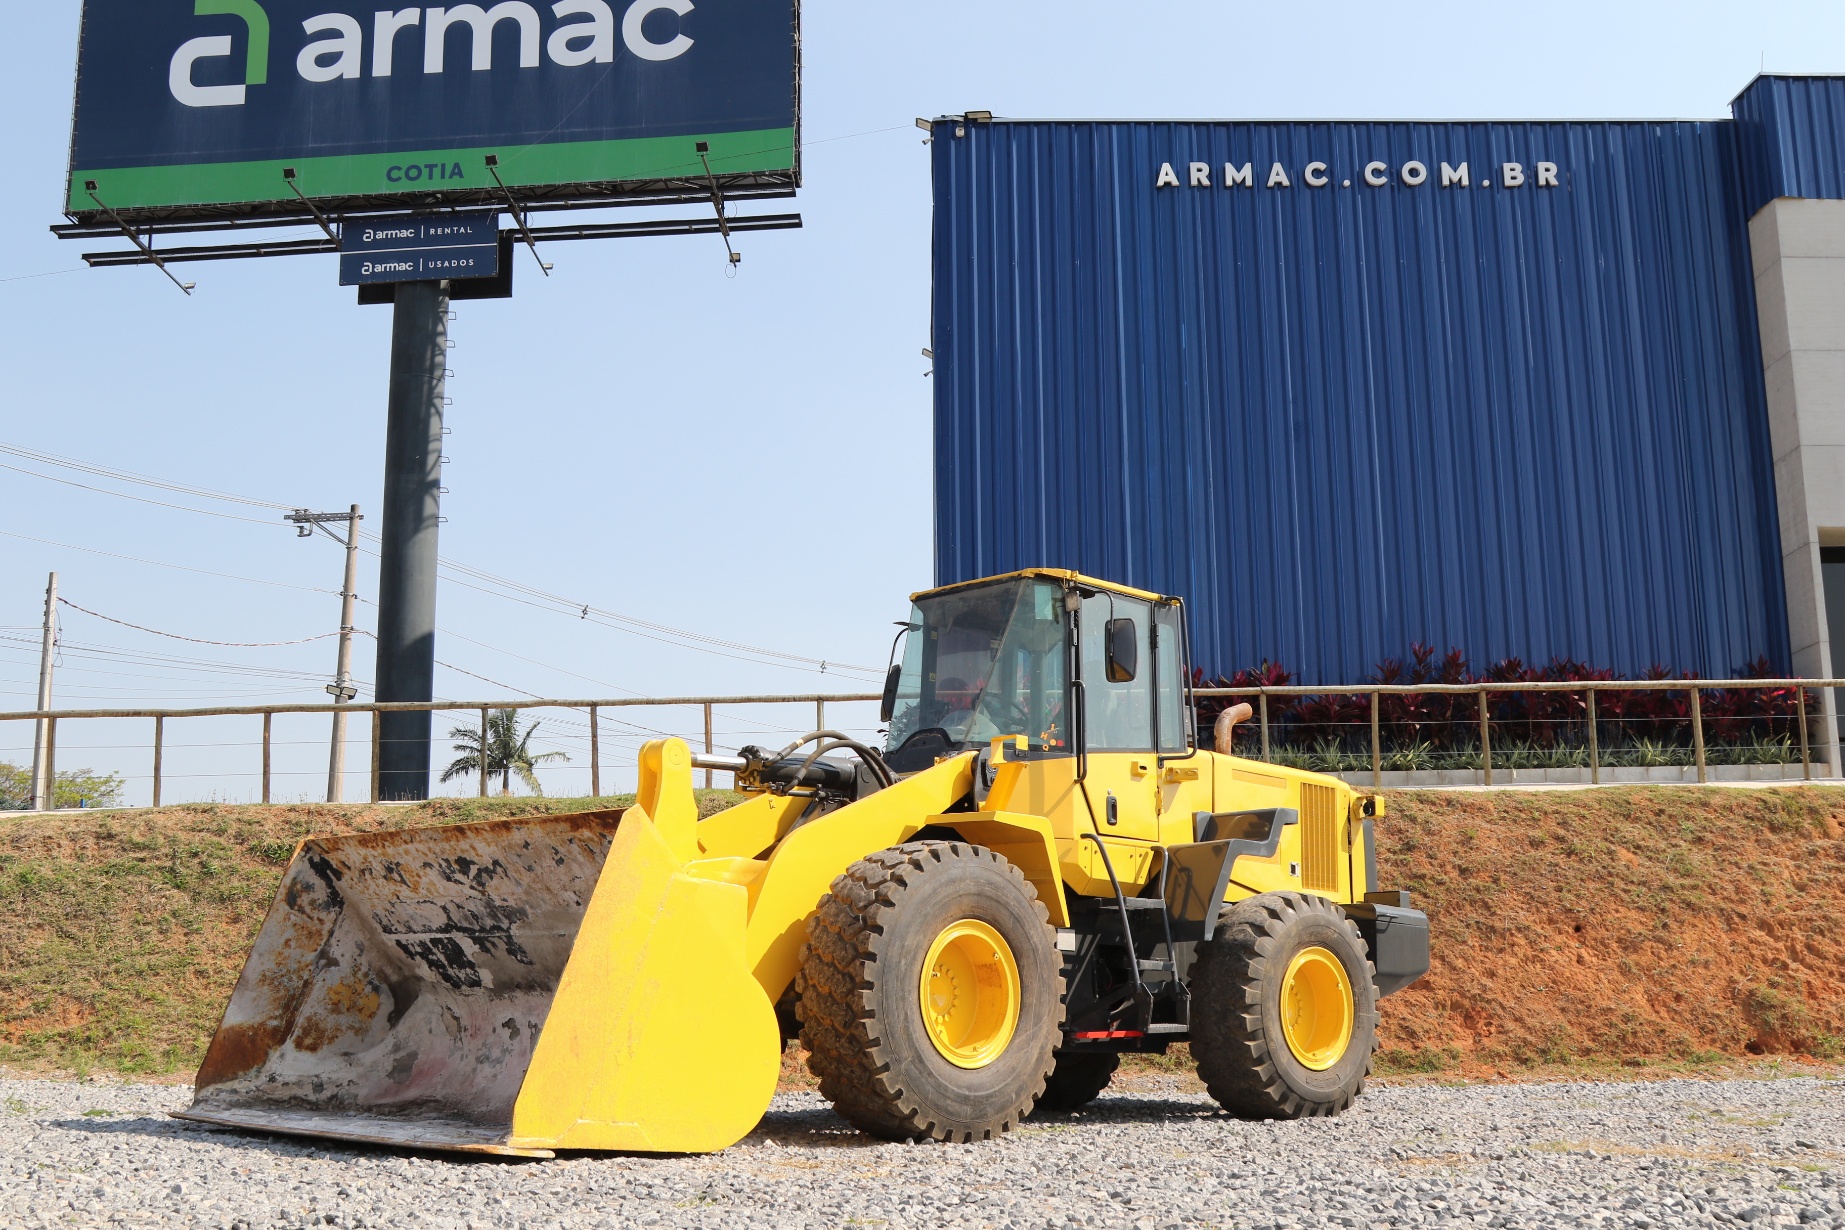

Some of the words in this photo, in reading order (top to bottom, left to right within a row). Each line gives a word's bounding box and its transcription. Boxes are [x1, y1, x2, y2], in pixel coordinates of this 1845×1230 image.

[296, 0, 695, 83] armac
[385, 162, 465, 183] COTIA
[1155, 160, 1560, 188] ARMAC.COM.BR
[375, 229, 415, 240] armac
[429, 226, 473, 236] RENTAL
[374, 262, 414, 273] armac
[428, 258, 475, 268] USADOS
